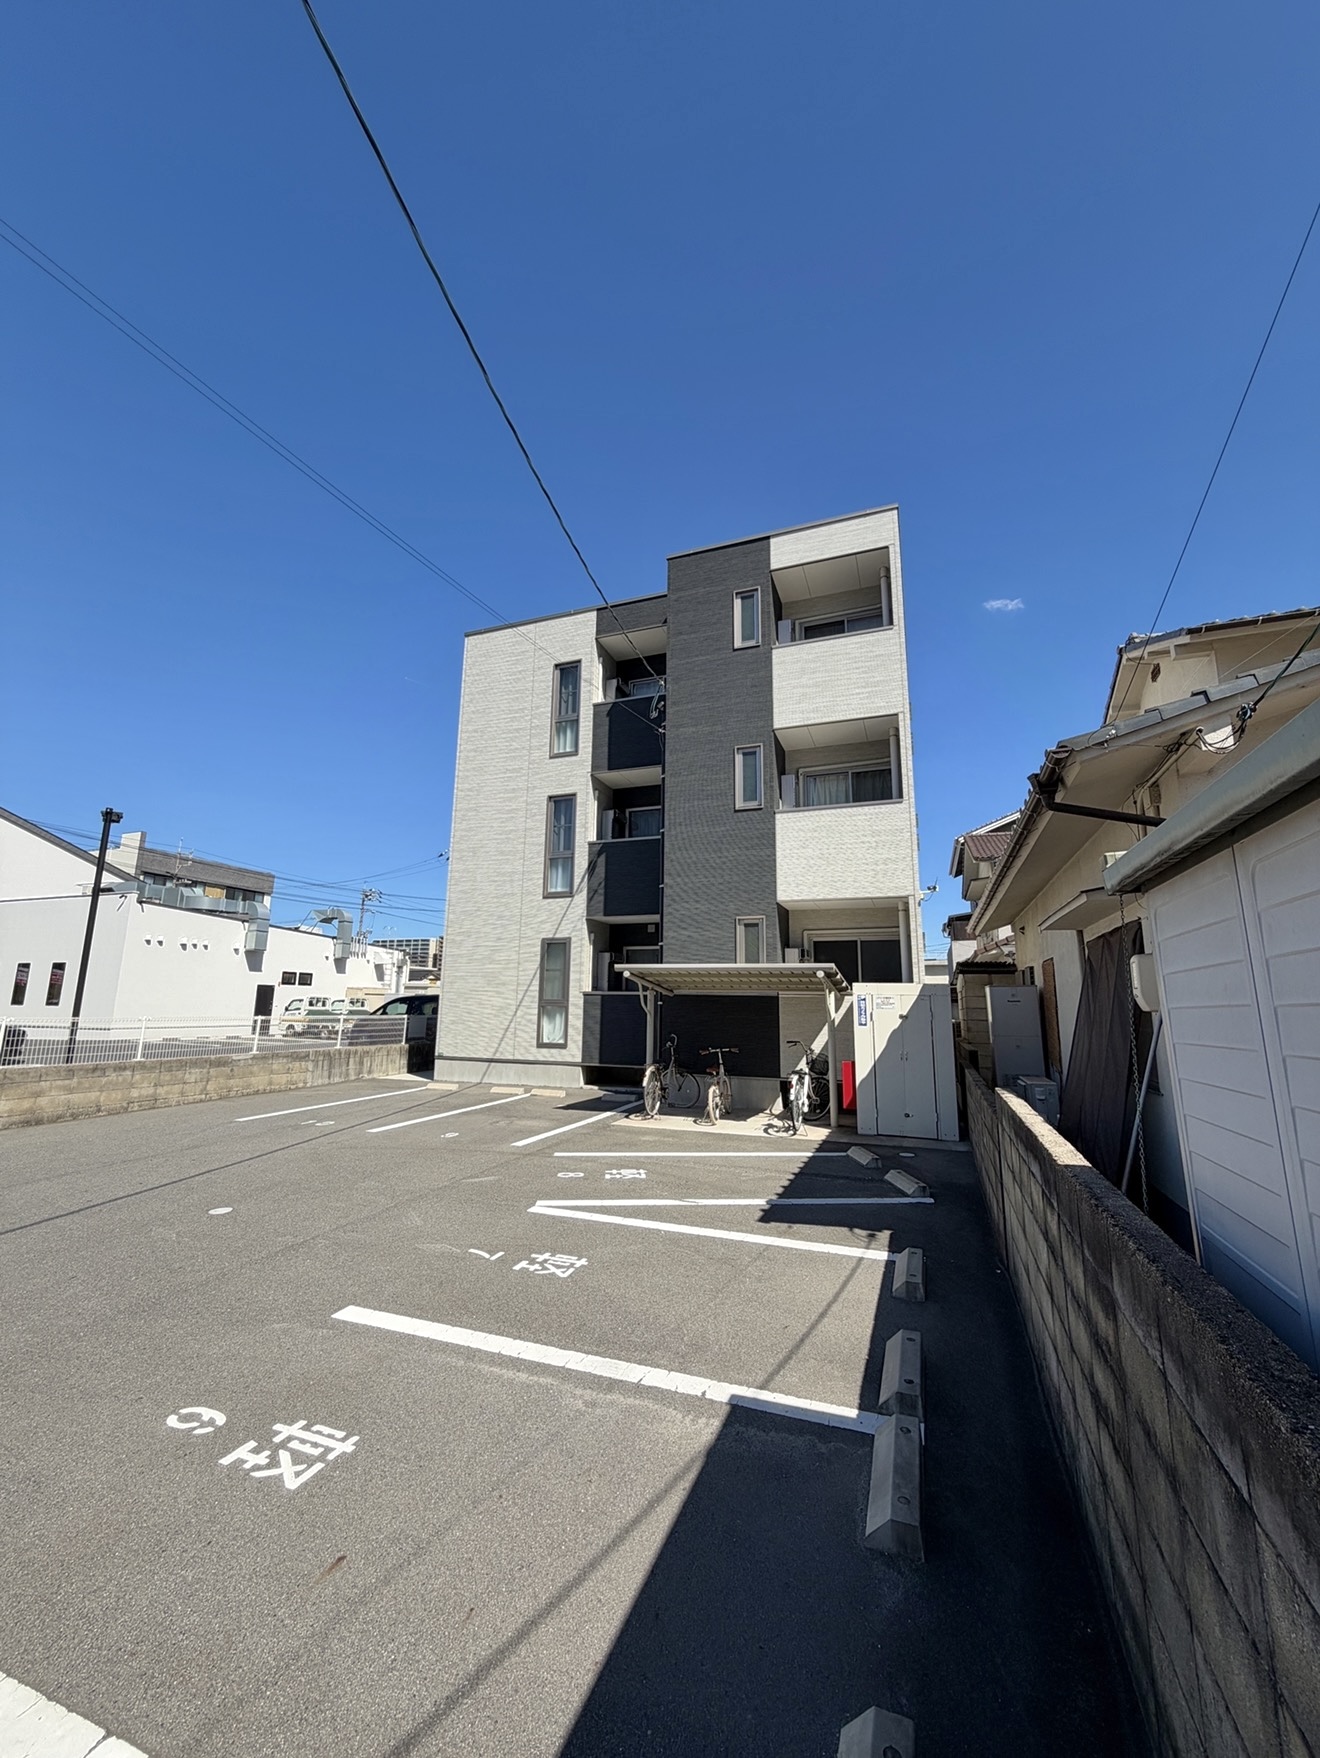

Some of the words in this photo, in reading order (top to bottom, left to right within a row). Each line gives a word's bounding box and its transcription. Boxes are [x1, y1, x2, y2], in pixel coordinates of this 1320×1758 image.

[604, 1168, 648, 1180] 軽
[468, 1248, 505, 1261] 7
[512, 1252, 589, 1278] 軽
[217, 1419, 361, 1490] 軽
